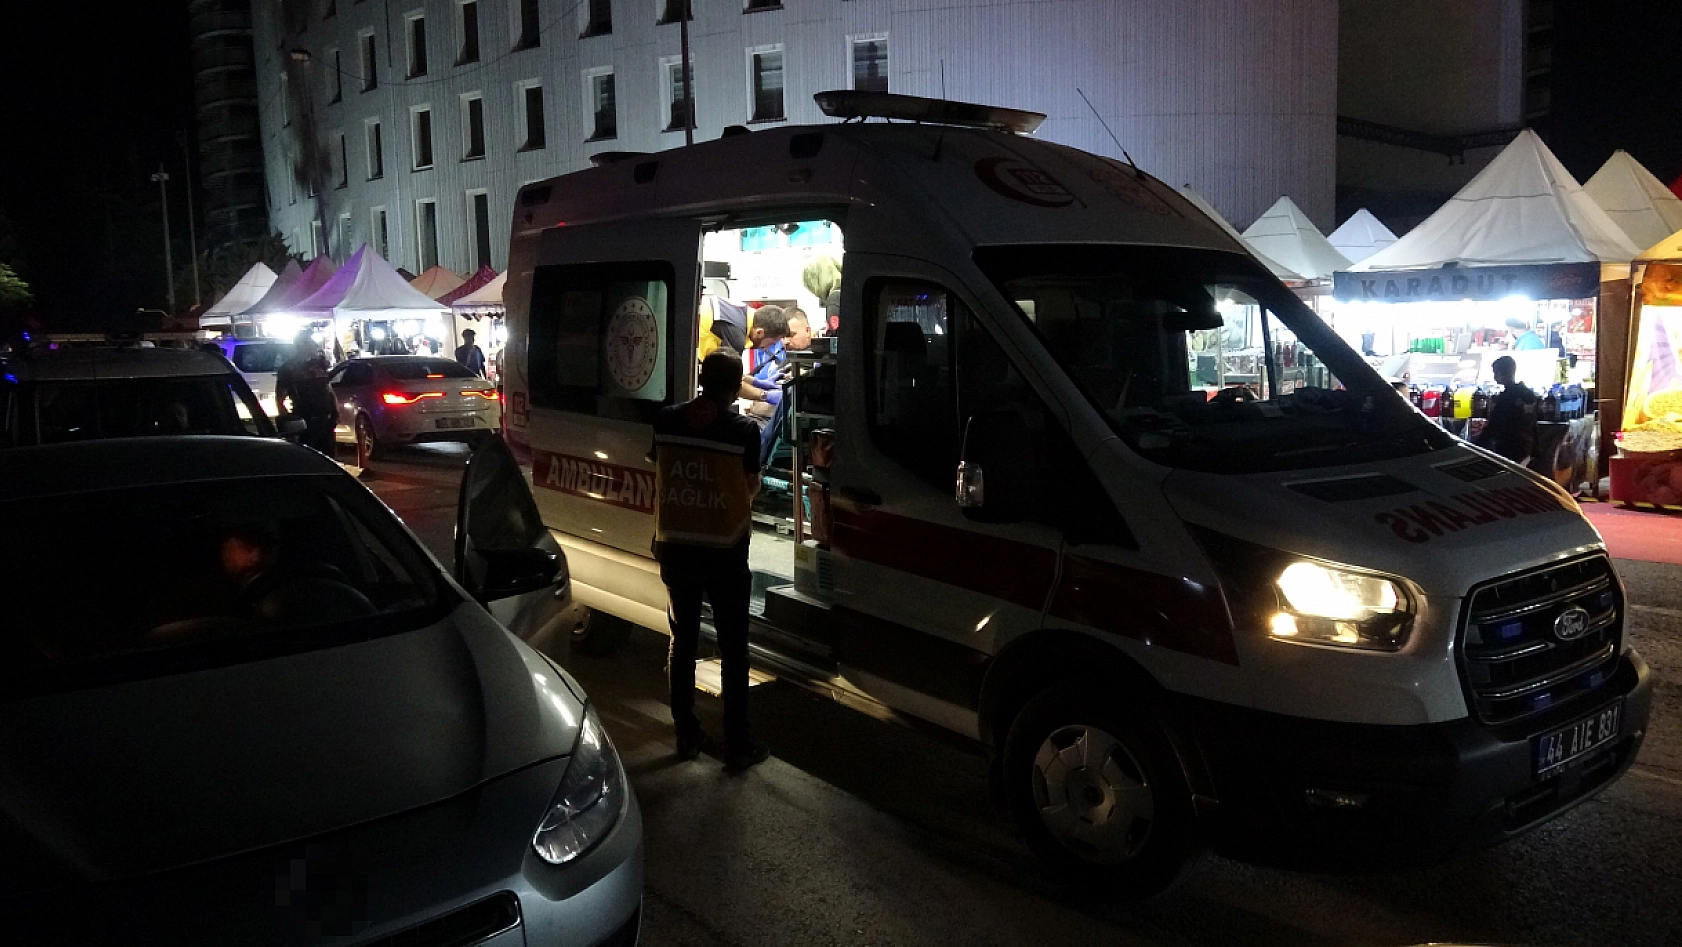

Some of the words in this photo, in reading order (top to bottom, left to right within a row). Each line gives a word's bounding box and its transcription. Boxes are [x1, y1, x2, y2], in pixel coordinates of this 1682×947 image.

[1361, 273, 1518, 298] KARADUT
[547, 454, 654, 509] AMBULAN
[1561, 612, 1585, 636] Ford
[1547, 732, 1563, 764] 44
